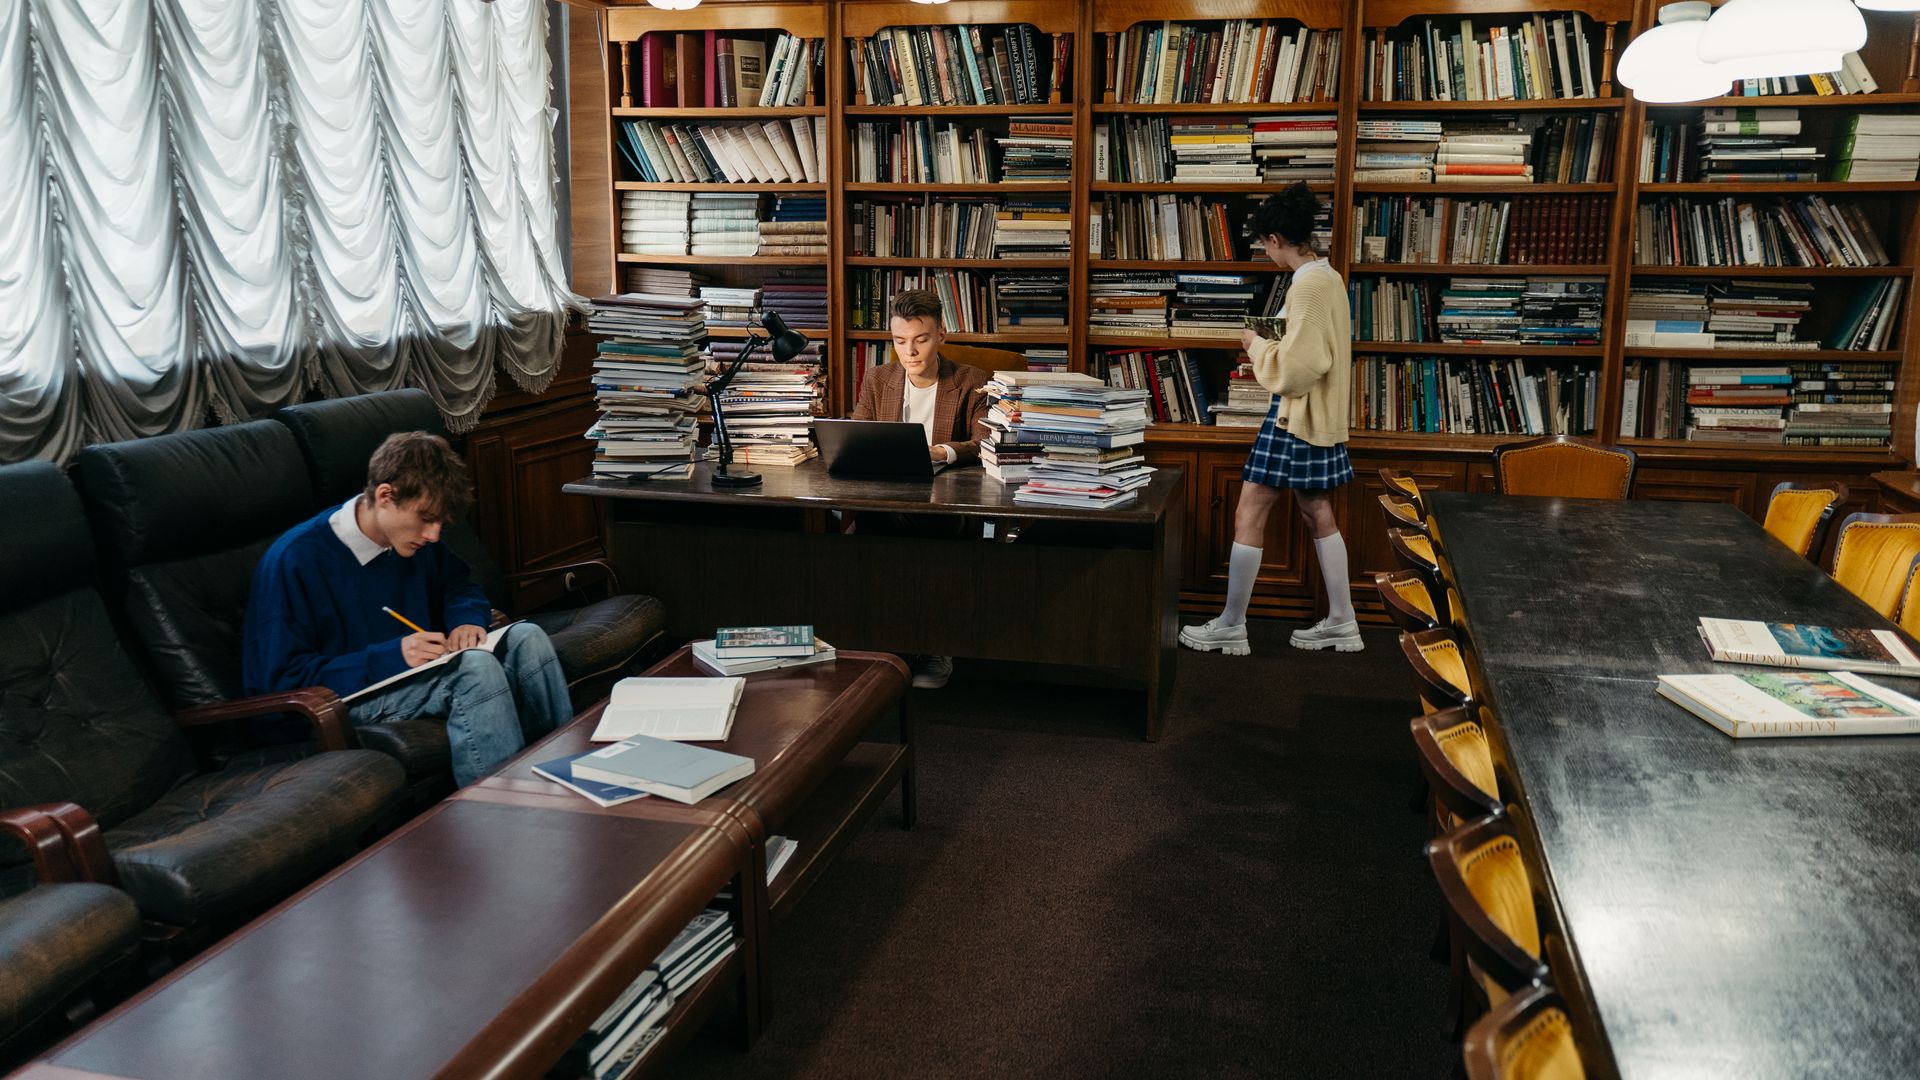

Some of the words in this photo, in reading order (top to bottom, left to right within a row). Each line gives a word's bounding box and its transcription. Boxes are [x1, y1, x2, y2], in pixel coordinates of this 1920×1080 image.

[1010, 36, 1020, 62] SCHRIFT
[1723, 651, 1800, 667] MÜNCHEN
[1750, 720, 1836, 733] KALKUTTA
